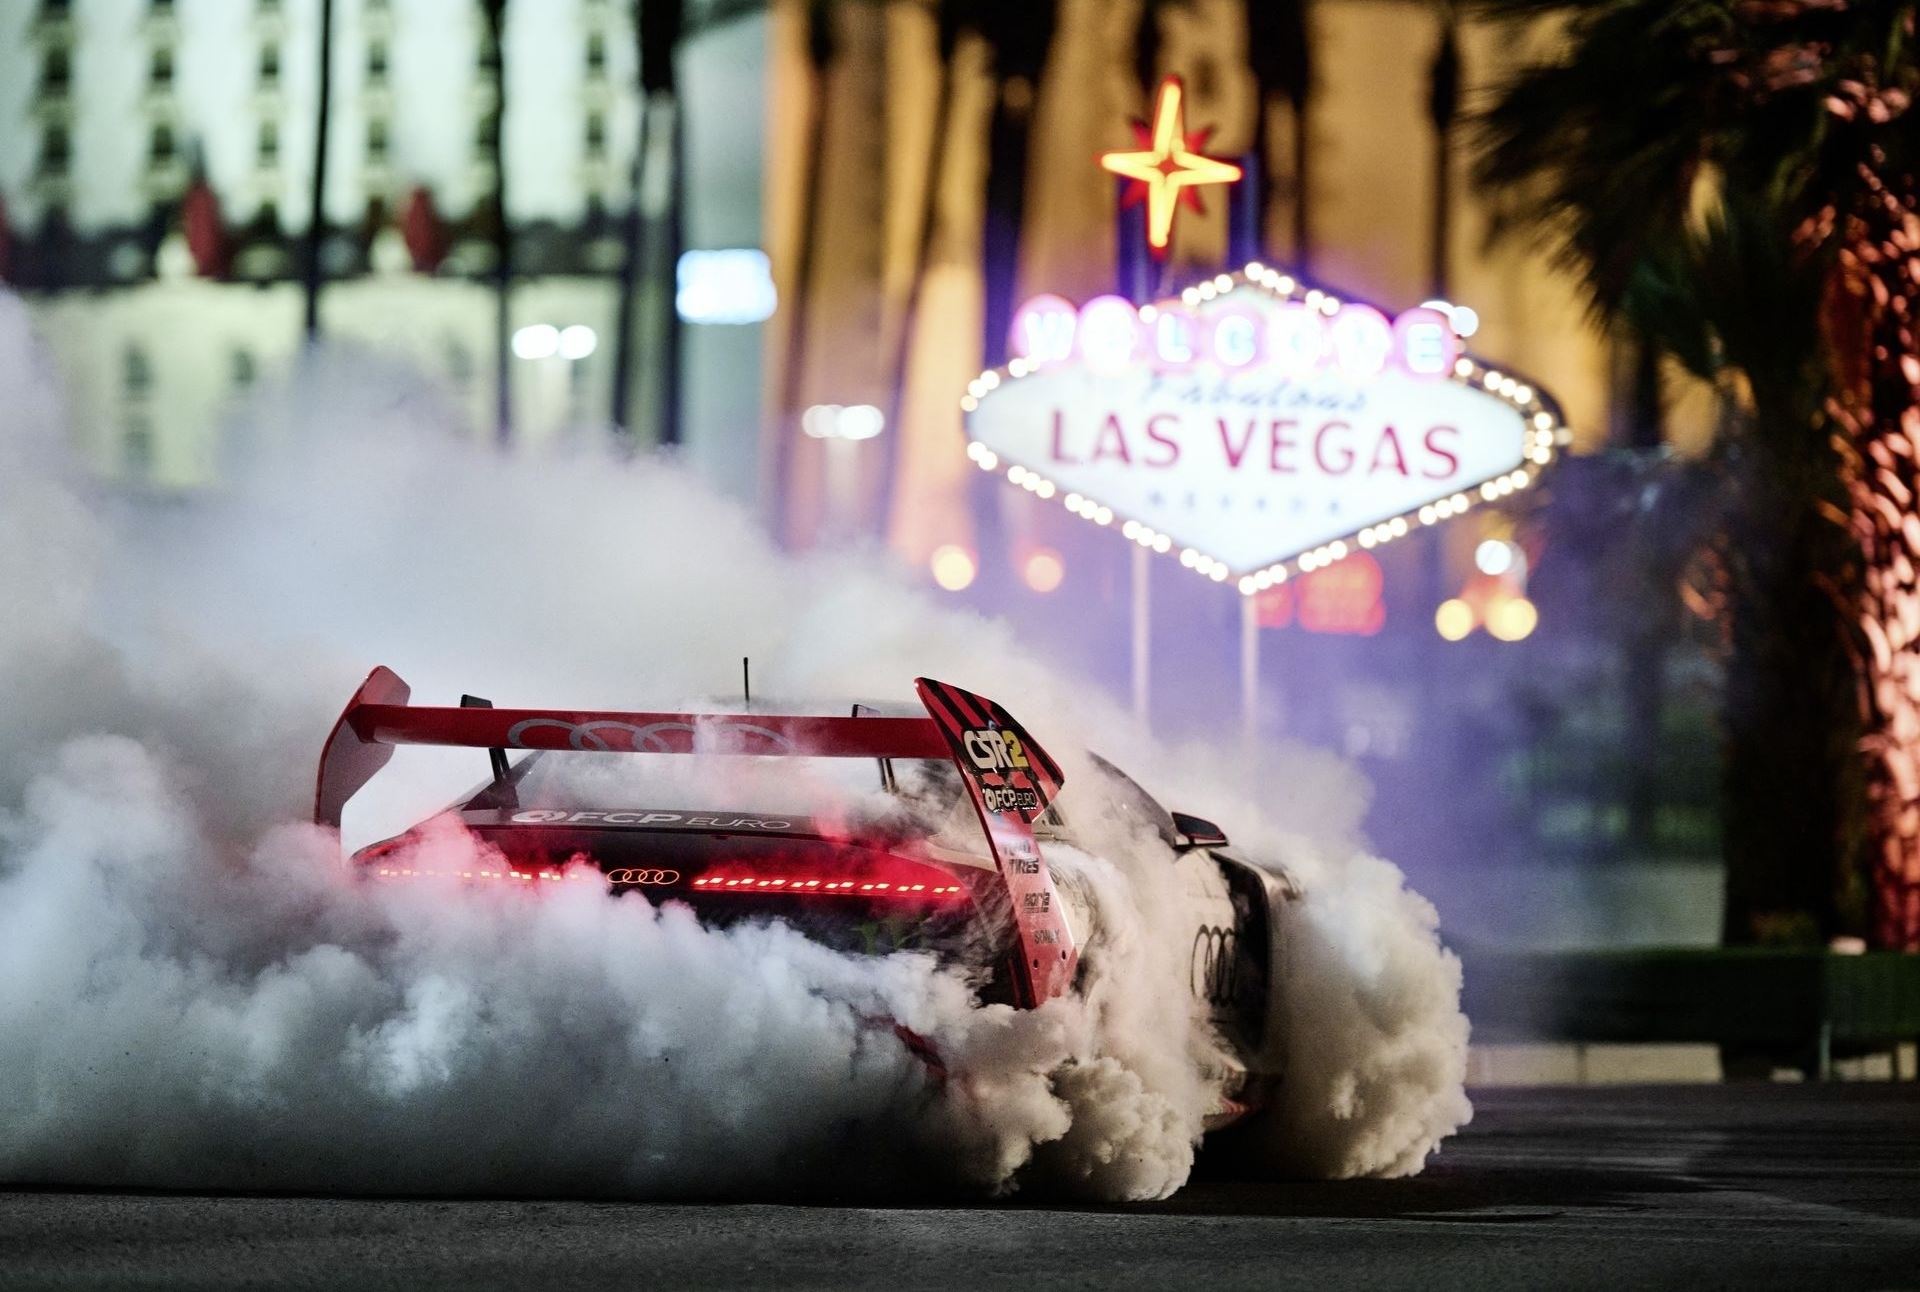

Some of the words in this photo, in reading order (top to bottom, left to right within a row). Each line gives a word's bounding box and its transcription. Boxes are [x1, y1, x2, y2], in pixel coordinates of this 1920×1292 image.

[1022, 307, 1448, 376] WLCOE
[1048, 408, 1182, 471] LAS
[1216, 415, 1461, 481] VEGAS
[963, 730, 1030, 769] CSR2
[567, 811, 682, 825] FCP
[686, 817, 791, 830] EURO
[1009, 857, 1039, 874] TIRES
